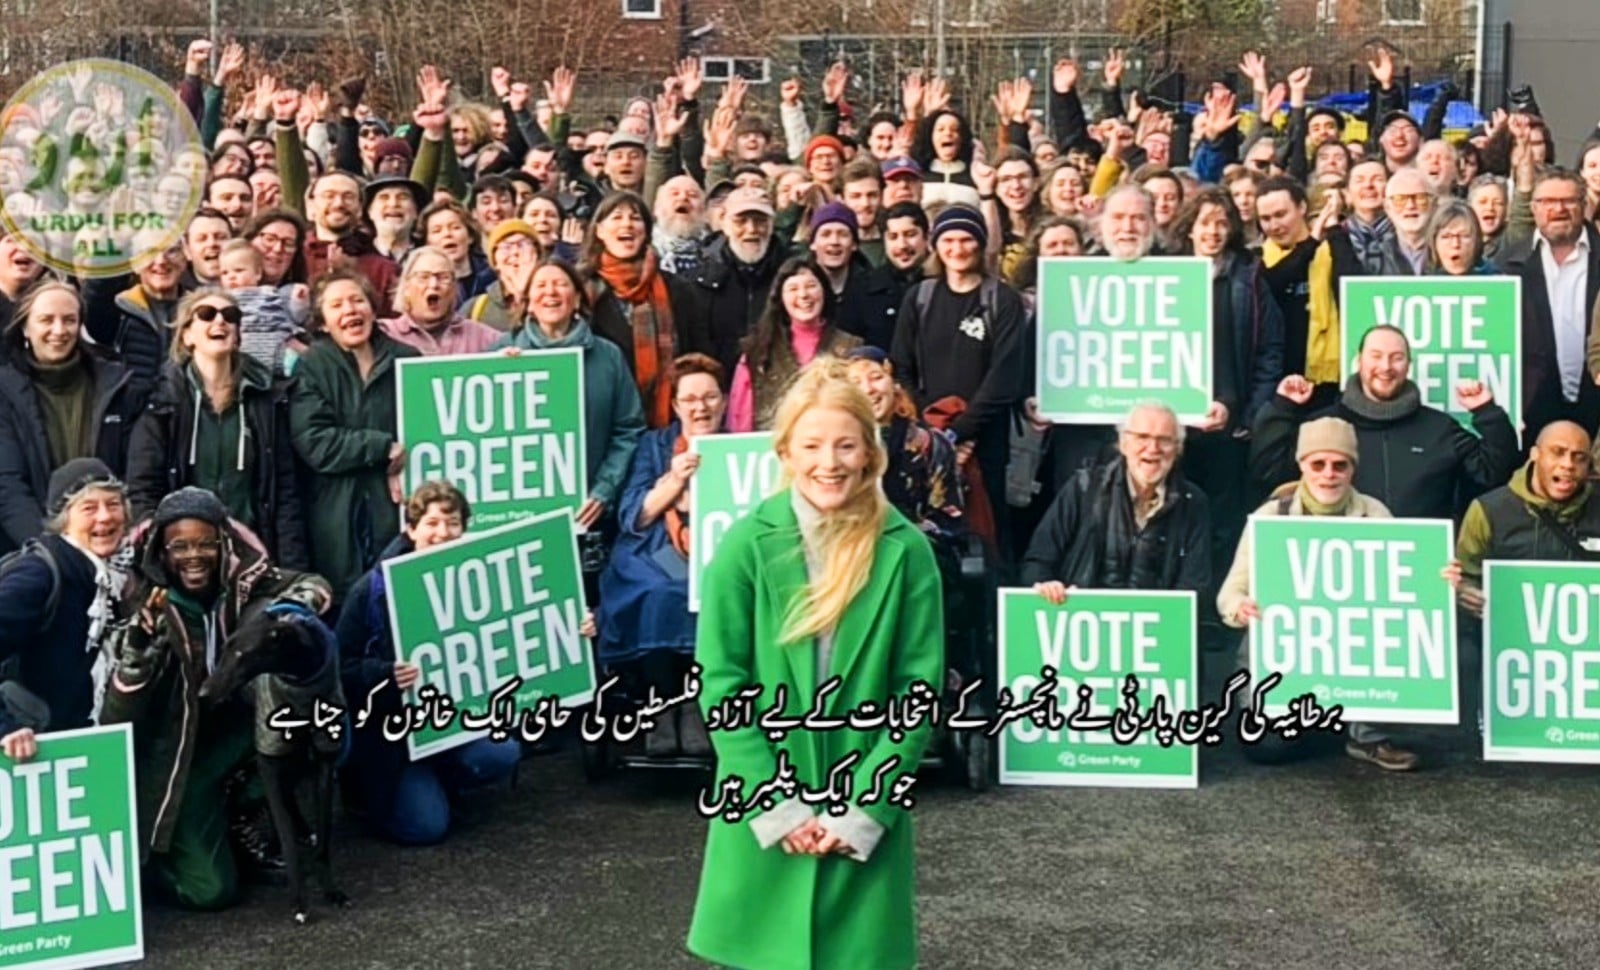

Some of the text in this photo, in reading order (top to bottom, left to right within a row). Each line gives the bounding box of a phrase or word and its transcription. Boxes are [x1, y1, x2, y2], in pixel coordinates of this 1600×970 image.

[1069, 274, 1180, 327] VOTE
[1373, 295, 1488, 349] VOTE
[1046, 329, 1203, 389] GREEN
[1352, 353, 1511, 414] EEN
[431, 370, 551, 436] VOTE
[409, 431, 577, 504] GREEN
[726, 451, 783, 506] VO
[422, 539, 550, 632] VOTE
[1286, 537, 1417, 603] VOTE
[1034, 610, 1161, 672] VOTE
[1261, 603, 1446, 680] GREEN
[1333, 687, 1399, 702] Green Party
[1496, 648, 1600, 720] GRE
[1078, 753, 1141, 768] Green Party
[1566, 729, 1600, 741] Green
[0, 830, 127, 930] EEN
[0, 934, 72, 956] reen Party
